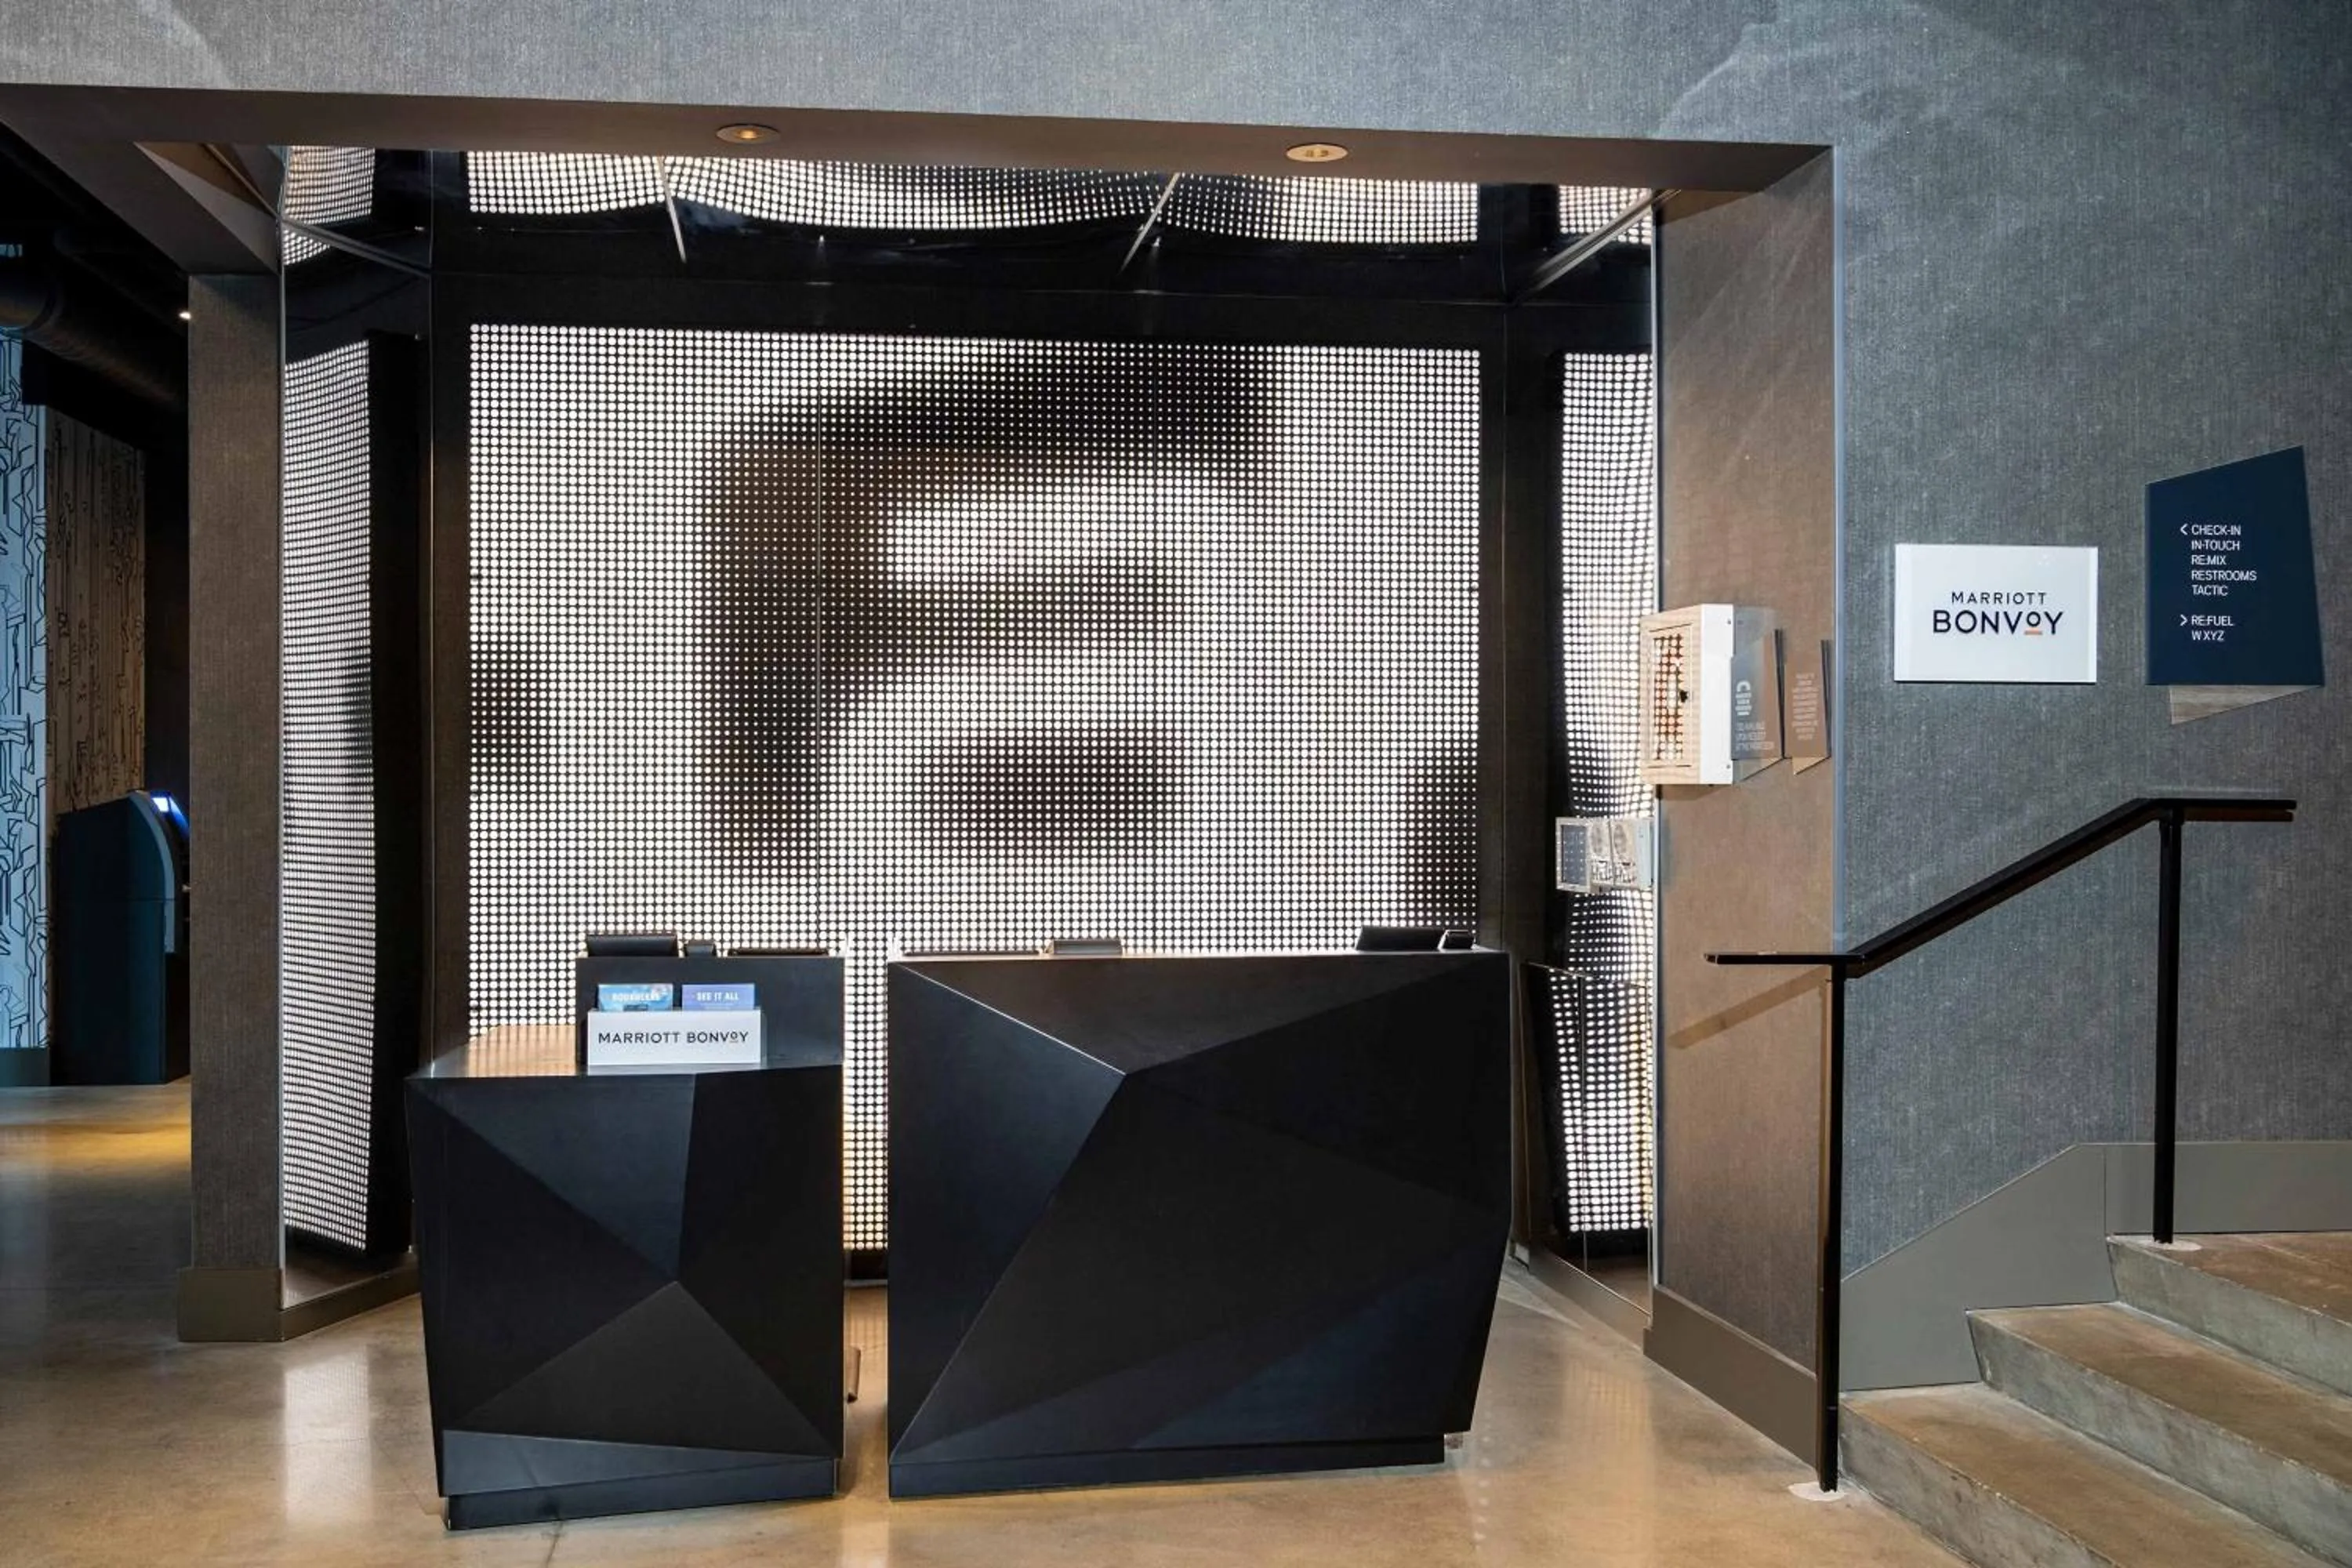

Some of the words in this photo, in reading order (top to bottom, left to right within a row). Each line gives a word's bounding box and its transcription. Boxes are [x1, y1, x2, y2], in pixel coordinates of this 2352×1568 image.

[2191, 524, 2241, 535] CHECK-IN
[2191, 570, 2257, 581] RESTROOMS
[2191, 584, 2228, 596] TACTIC
[1951, 591, 2048, 604] MARRIOTT
[1933, 609, 2063, 635] BONVOY
[695, 991, 712, 1001] SEE
[714, 991, 722, 1002] IT
[724, 991, 739, 1001] ALL
[598, 1032, 681, 1044] MARRIOTT
[686, 1031, 749, 1044] BONVOY
